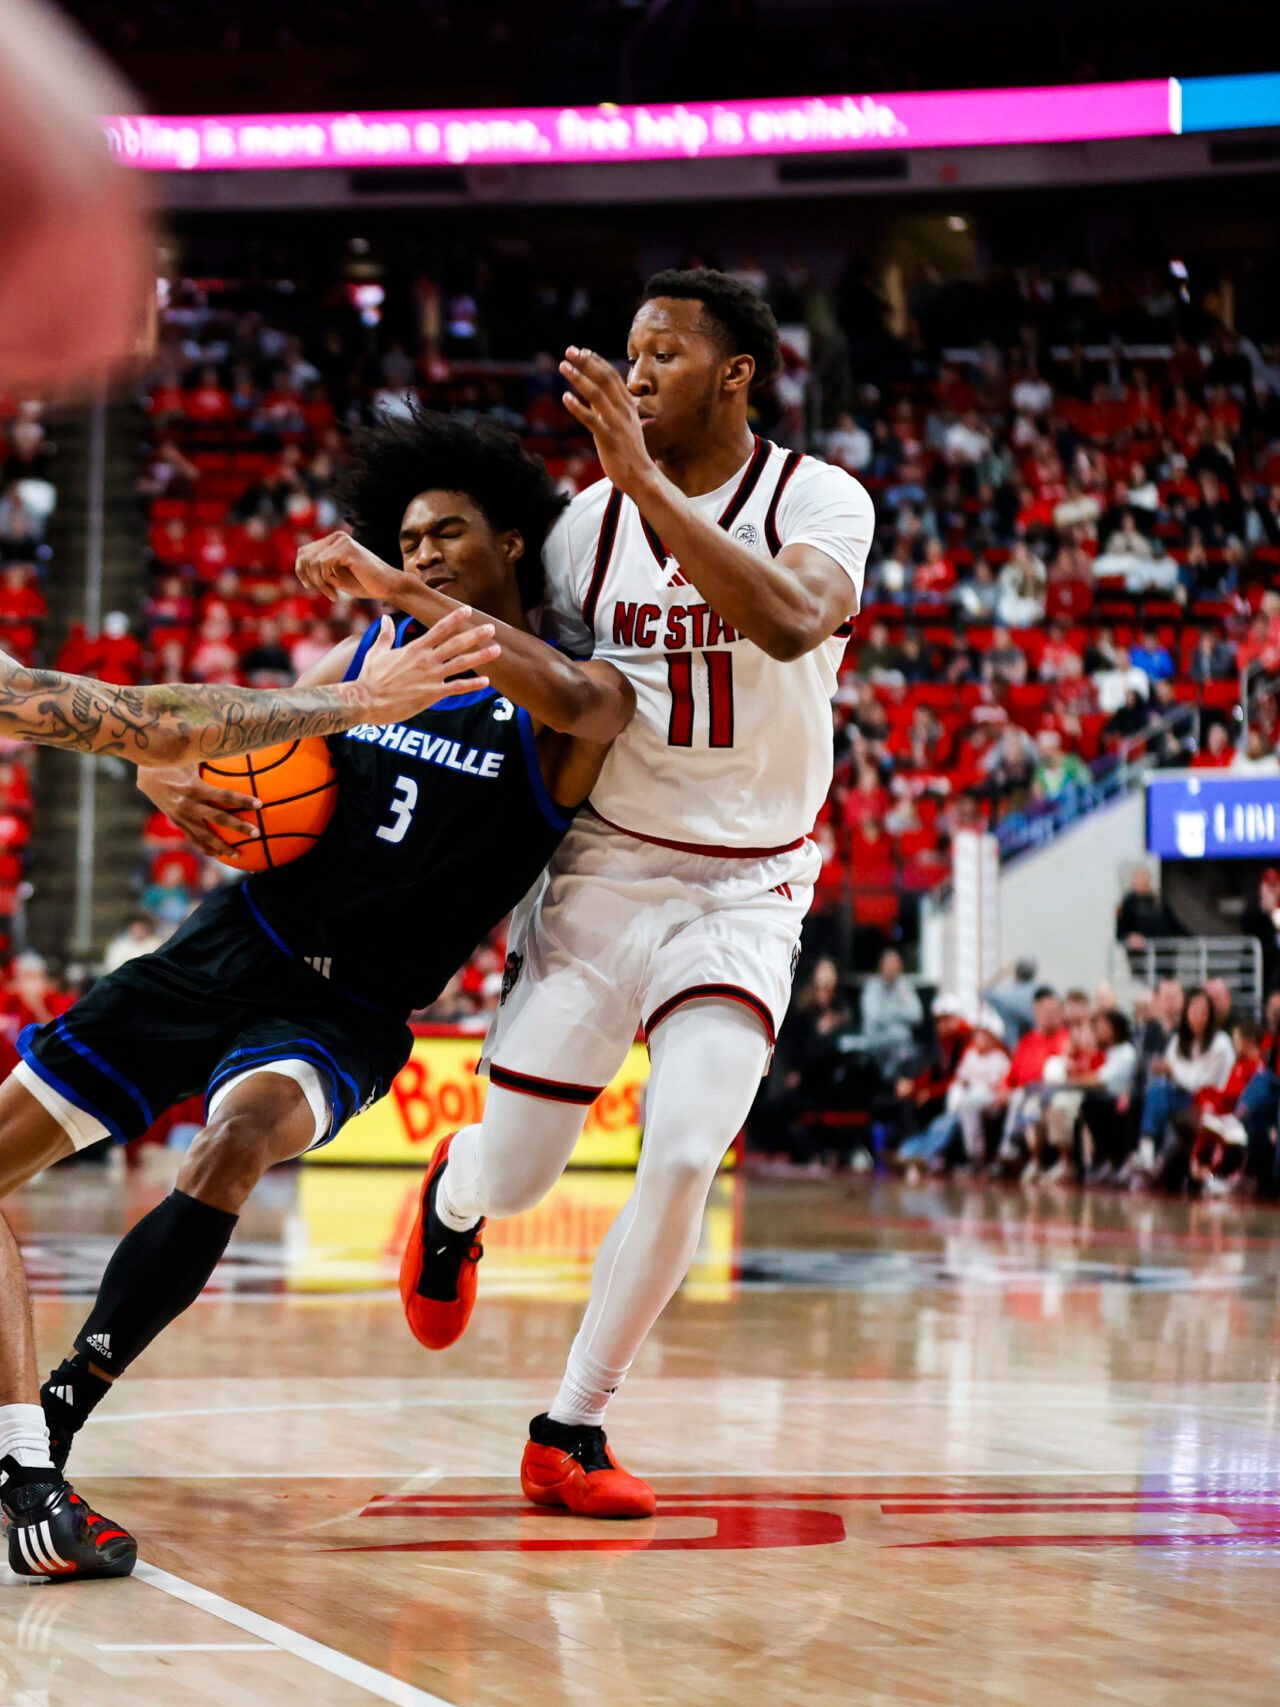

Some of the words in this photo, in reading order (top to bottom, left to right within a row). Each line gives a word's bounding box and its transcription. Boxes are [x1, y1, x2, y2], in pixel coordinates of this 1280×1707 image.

[237, 123, 327, 157] more
[328, 112, 411, 155] than
[558, 108, 632, 151] free
[634, 105, 709, 157] help
[613, 600, 662, 649] NC
[664, 602, 748, 650] STA
[664, 651, 734, 748] 11
[345, 722, 505, 778] ASHEVILLE
[375, 775, 418, 843] 3
[86, 1335, 113, 1359] adidas
